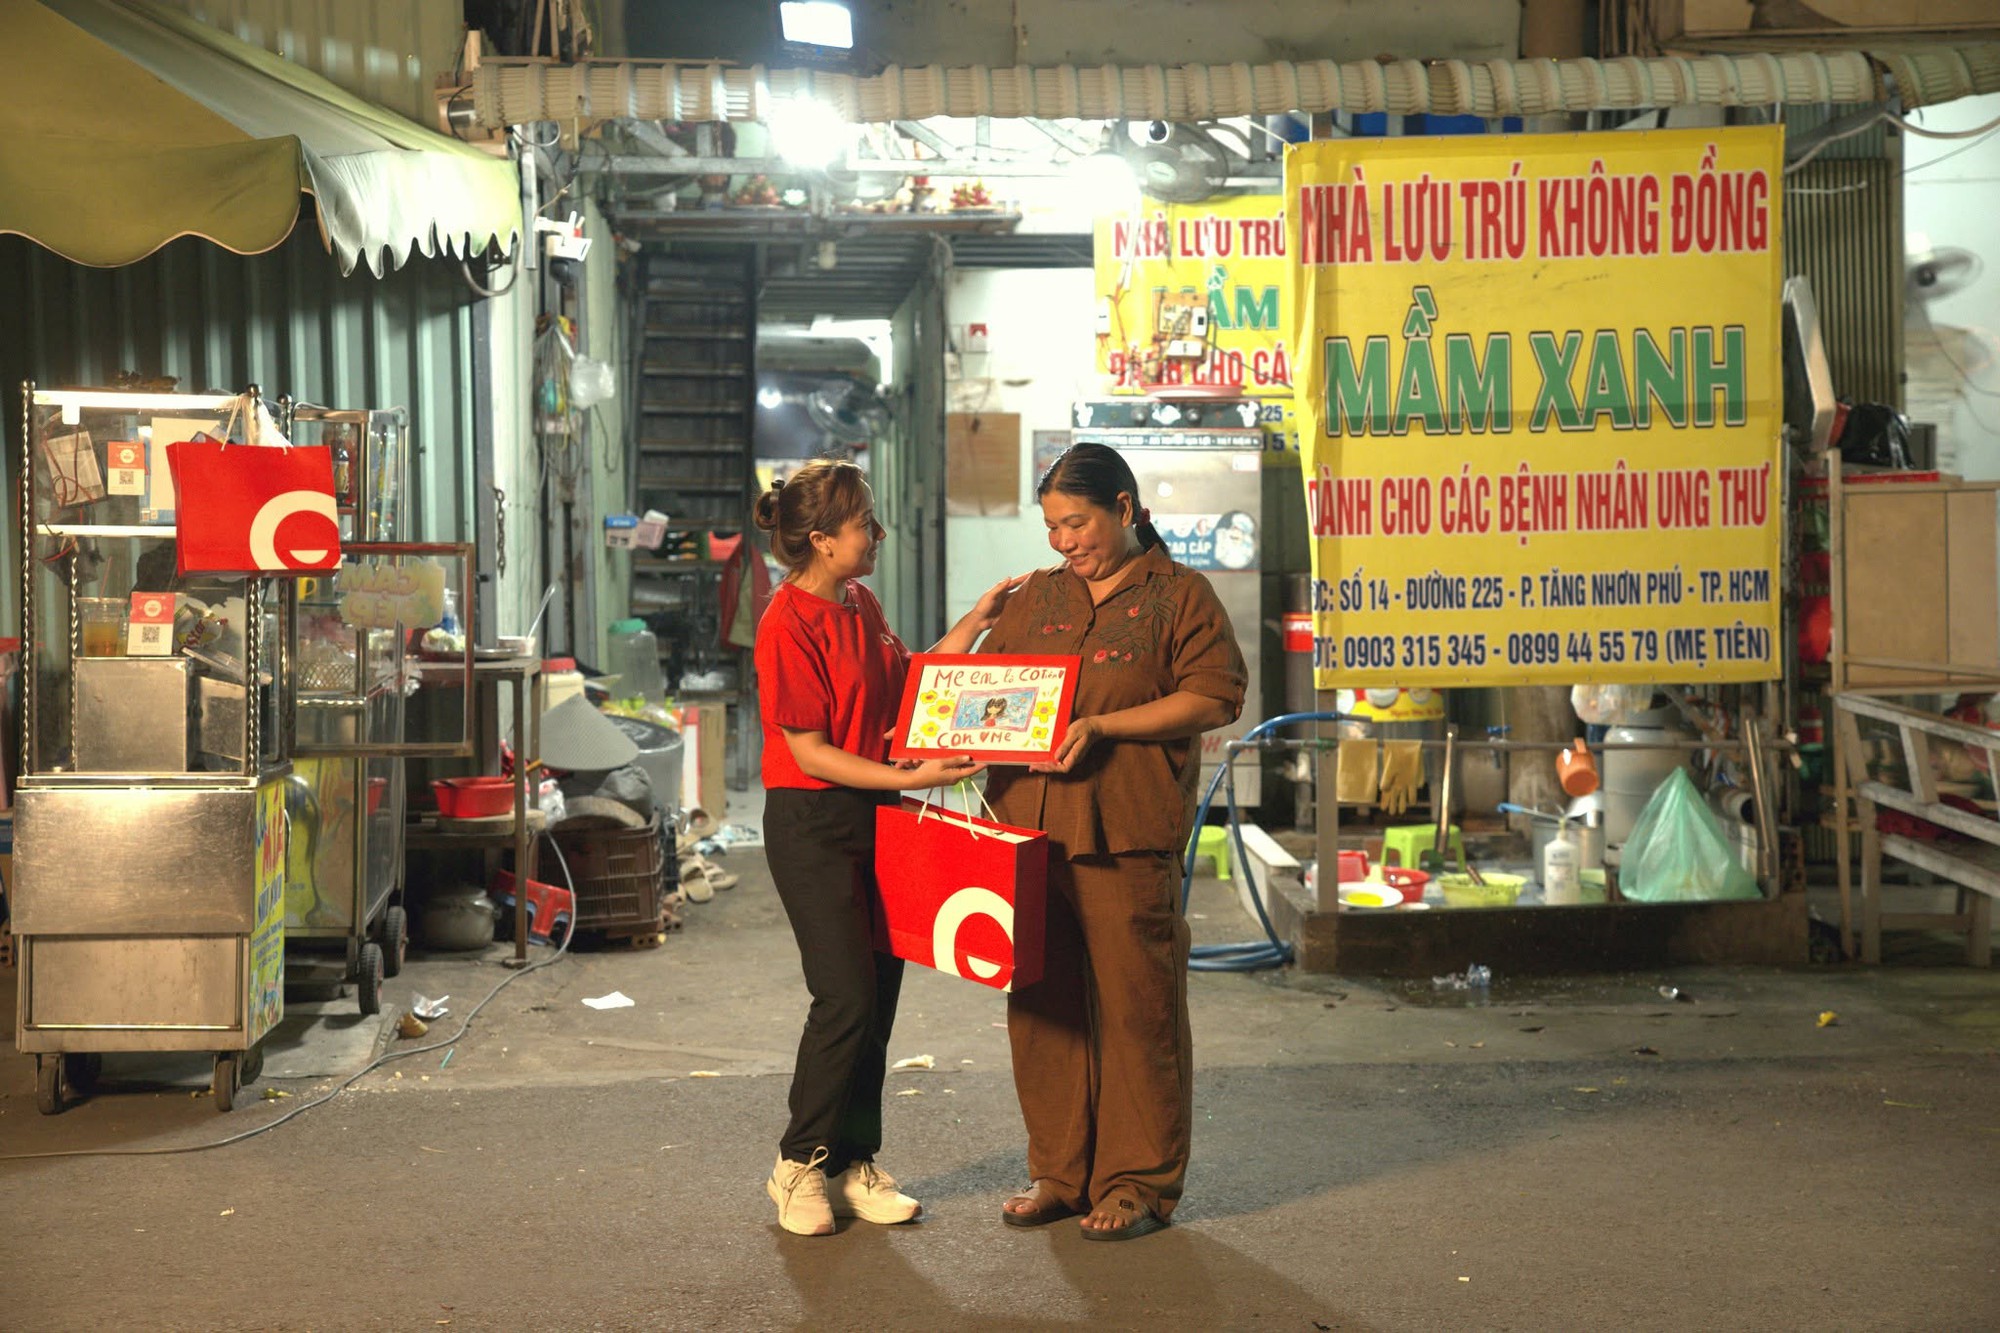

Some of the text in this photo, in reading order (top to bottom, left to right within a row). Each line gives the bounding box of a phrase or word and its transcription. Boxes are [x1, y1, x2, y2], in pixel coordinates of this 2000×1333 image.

[1301, 145, 1768, 264] NHÀ LƯU TRÚ KHÔNG ĐỒNG
[1253, 342, 1294, 386] CÁ
[1325, 285, 1746, 438] MẦM XANH
[1380, 477, 1431, 535] CHO
[1440, 464, 1491, 534] CÁC
[1499, 462, 1567, 545] BỆNH
[1576, 460, 1648, 530] NHÂN
[1657, 470, 1710, 529] UNG
[1718, 462, 1770, 527] THƯ
[1339, 567, 1363, 612] SỐ
[1368, 580, 1389, 610] 14
[1394, 592, 1402, 600] -
[1406, 571, 1466, 610] ĐƯỜNG
[1471, 577, 1503, 609] 225
[1508, 590, 1516, 598] -
[1521, 576, 1535, 607] P.
[1539, 569, 1586, 607] TĂNG
[1591, 570, 1641, 606] NHƠN
[1646, 565, 1682, 604] PHÚ
[1687, 585, 1696, 593] -
[1699, 571, 1725, 603] TP.
[1729, 569, 1770, 603] HCM
[1344, 636, 1395, 668] 0903
[1402, 635, 1441, 667] 315
[1447, 634, 1486, 666] 345
[1492, 647, 1502, 656] -
[1508, 632, 1560, 665] 0899
[1566, 632, 1593, 663] 44
[1599, 631, 1625, 663] 55
[1631, 630, 1658, 662] 79
[1665, 628, 1708, 668] (MẸ
[1712, 620, 1771, 663] TIÊN)
